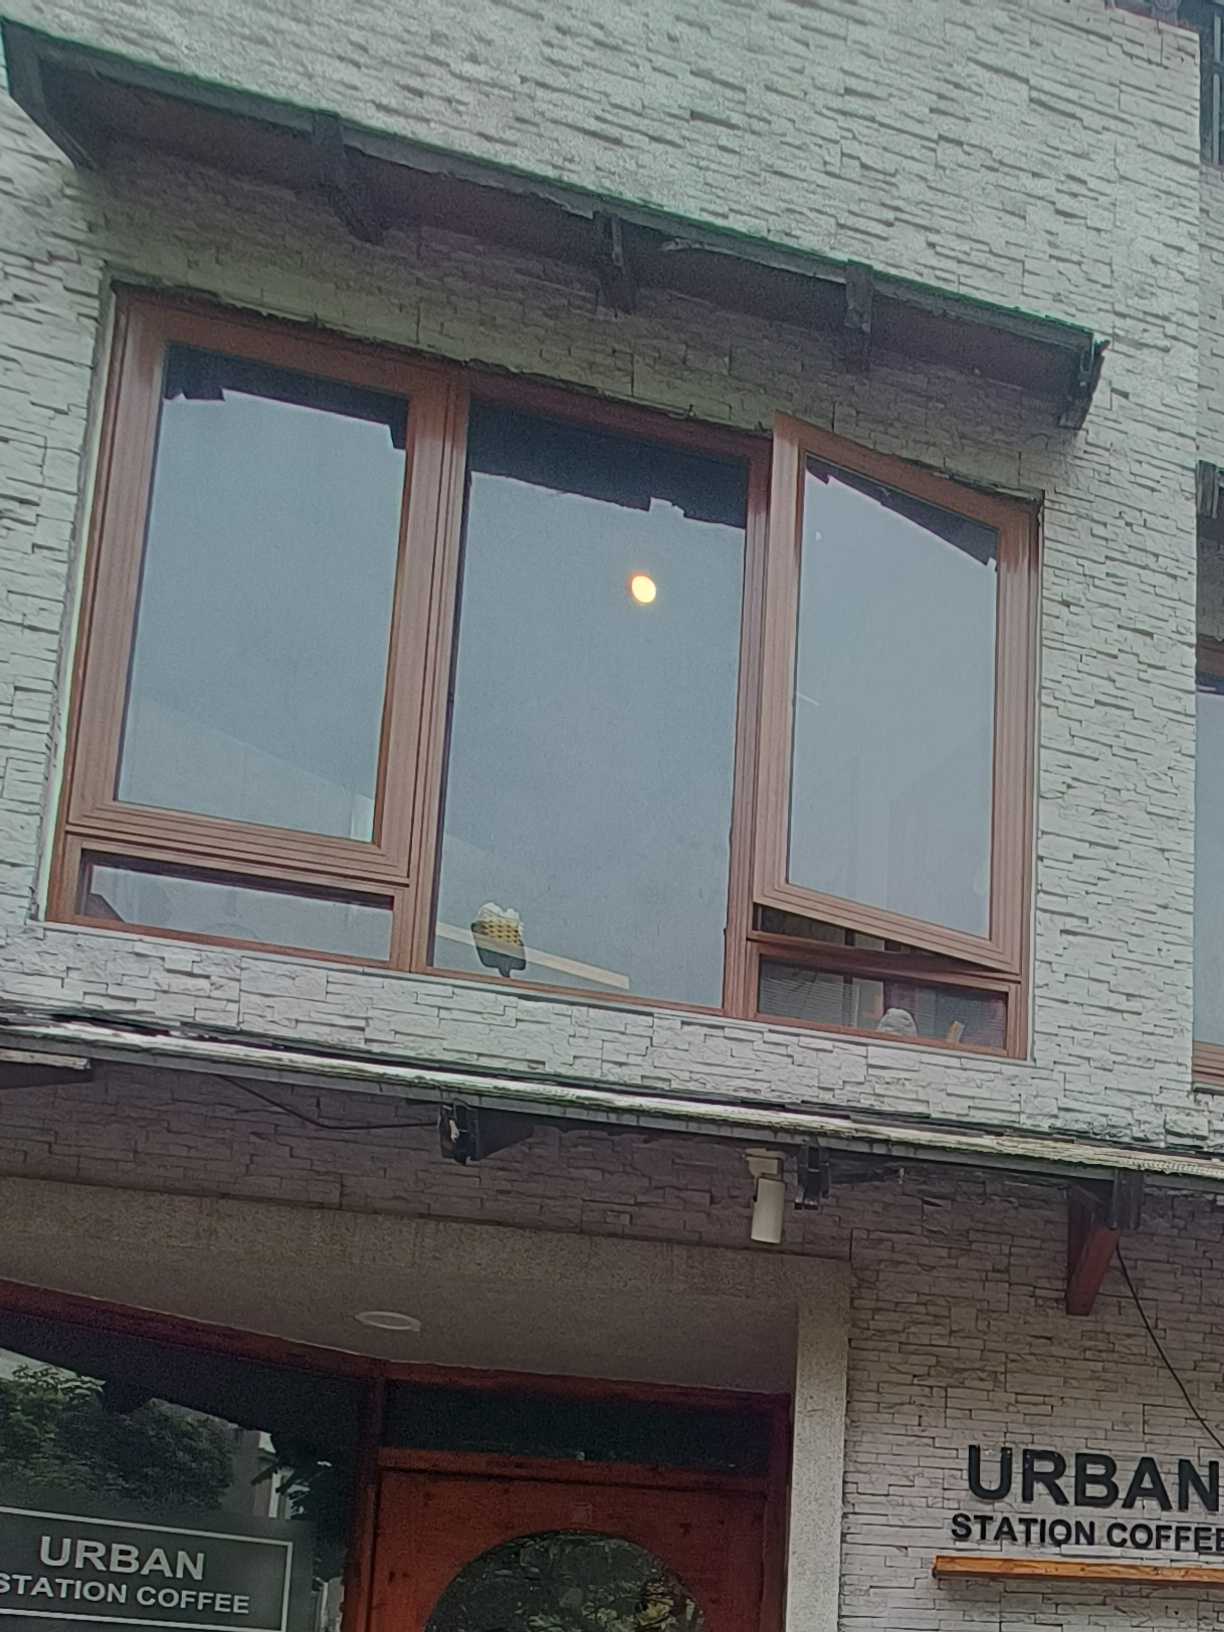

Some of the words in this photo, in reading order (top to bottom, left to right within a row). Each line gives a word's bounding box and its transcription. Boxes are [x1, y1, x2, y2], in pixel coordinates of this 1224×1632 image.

[968, 1443, 1220, 1512] URBAN
[951, 1512, 1096, 1547] STATION
[40, 1535, 206, 1581] URBAN
[136, 1586, 250, 1614] COFFEE
